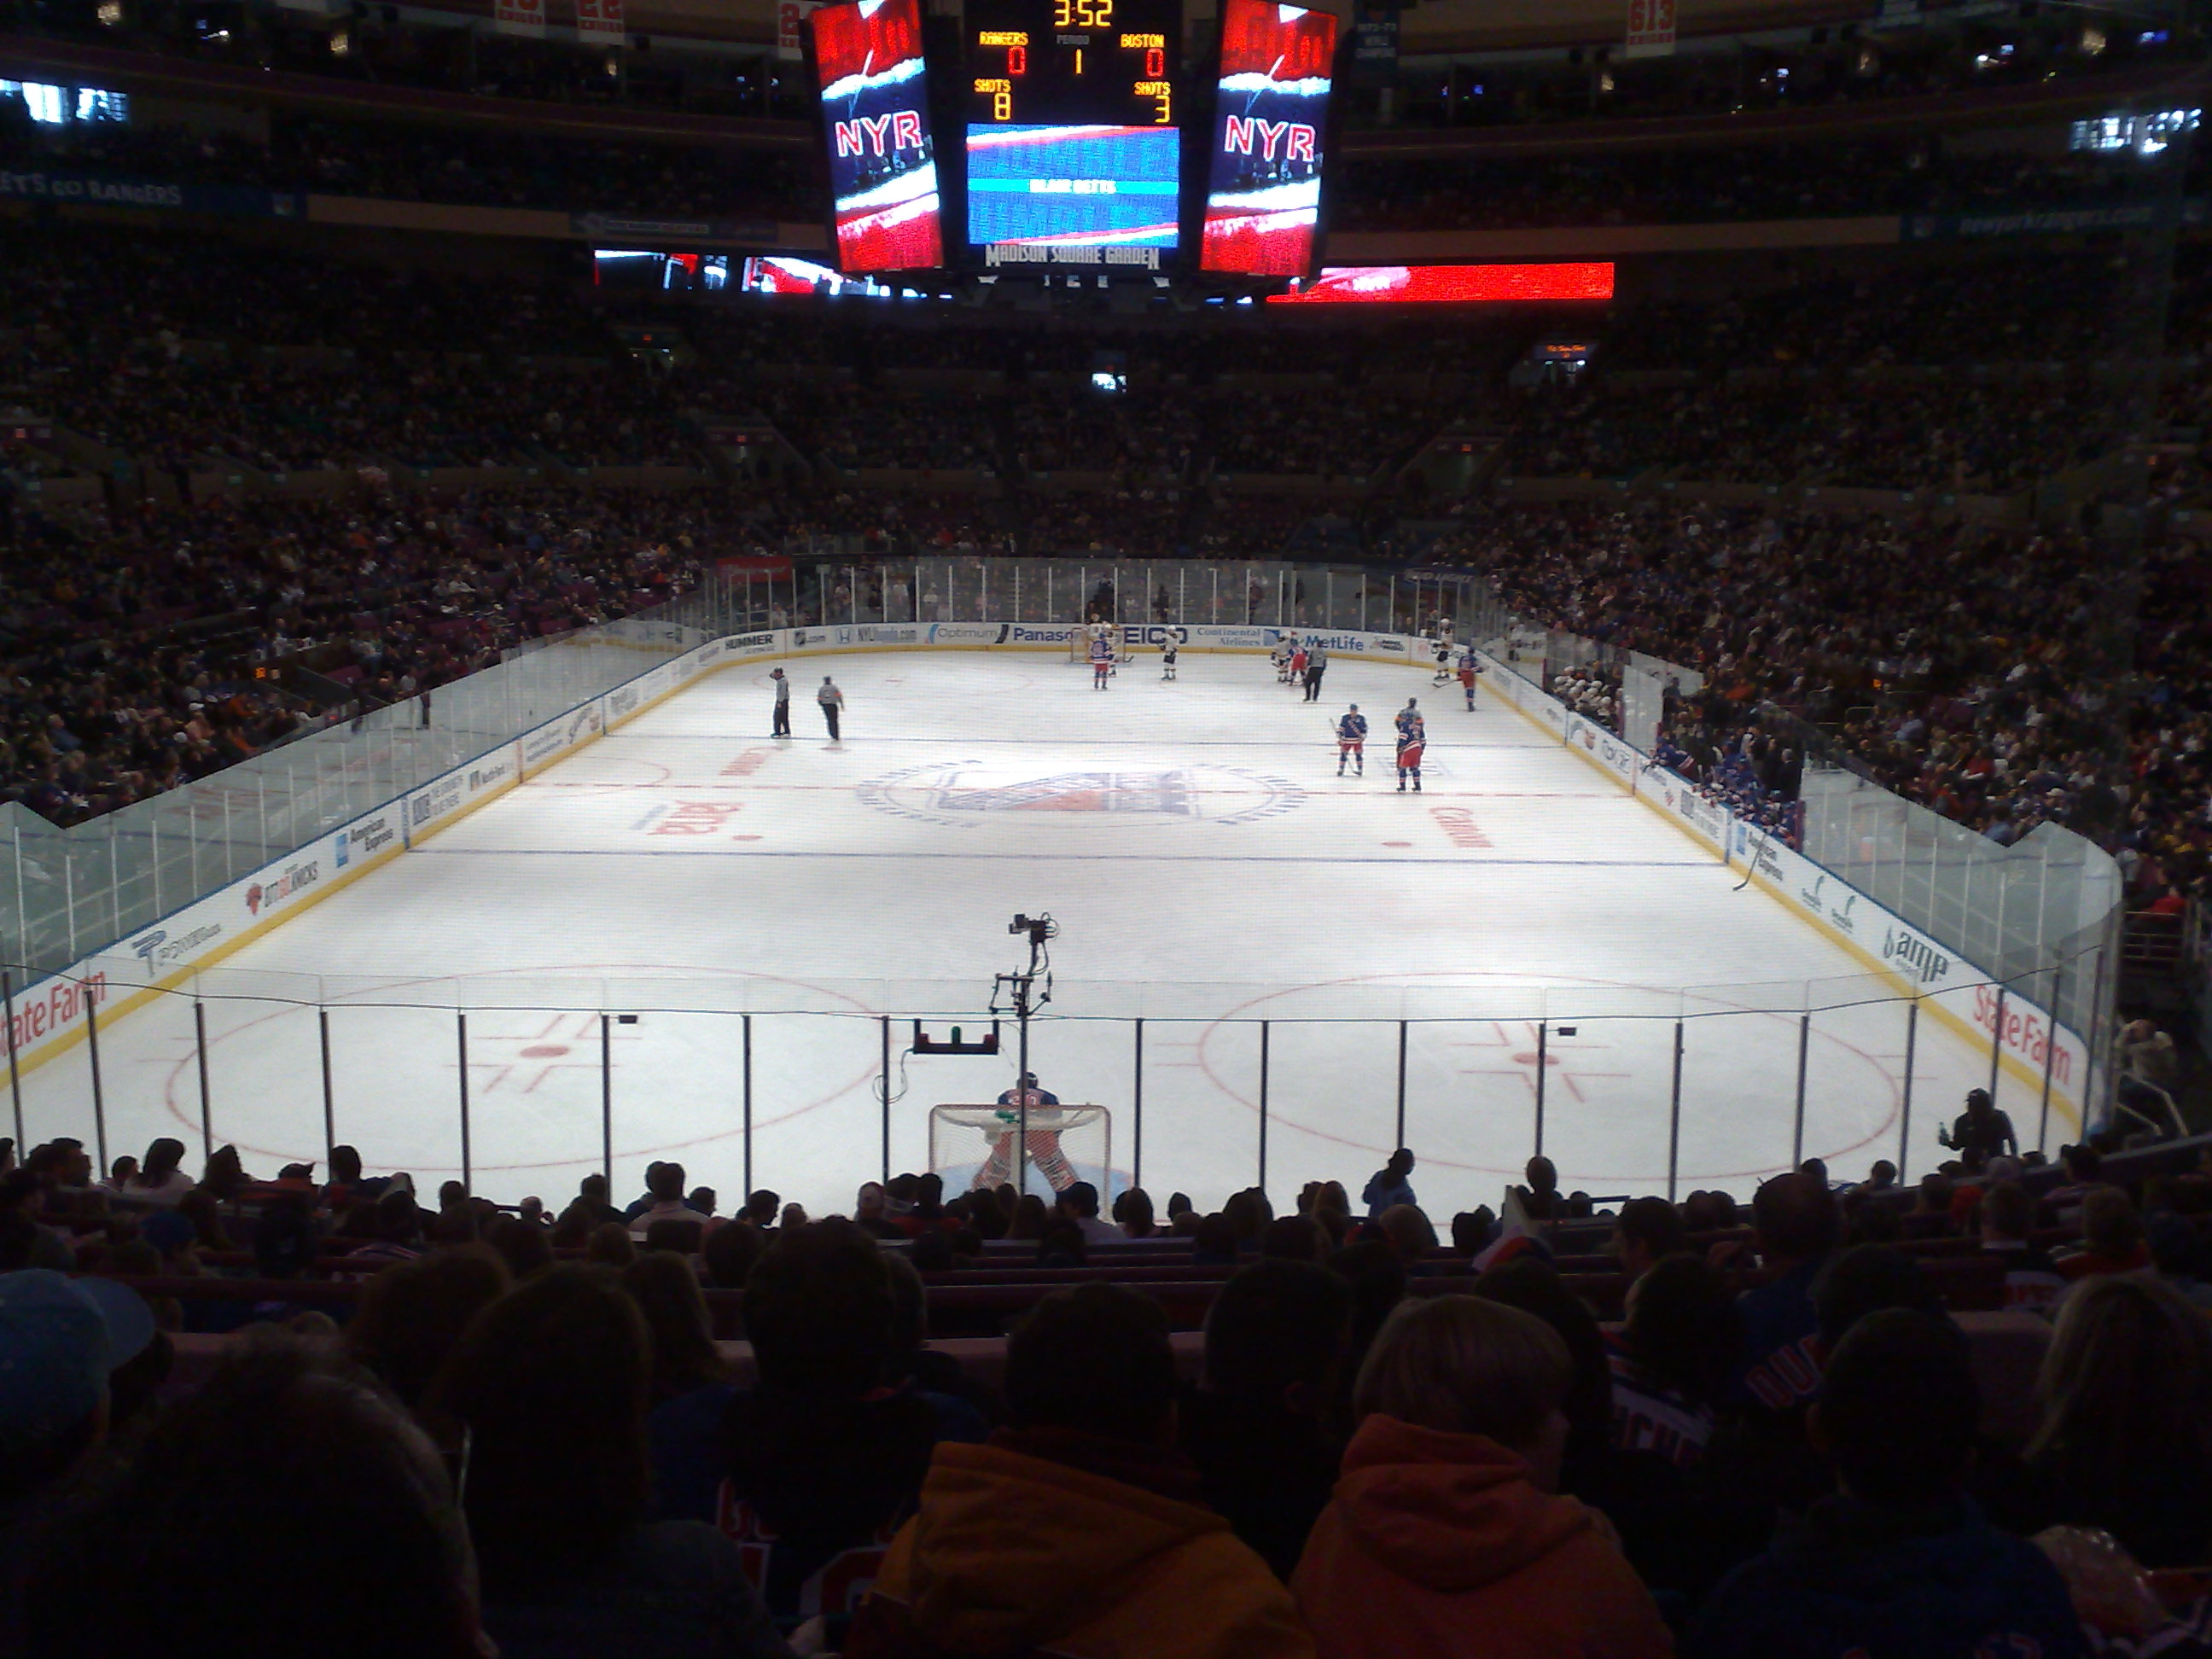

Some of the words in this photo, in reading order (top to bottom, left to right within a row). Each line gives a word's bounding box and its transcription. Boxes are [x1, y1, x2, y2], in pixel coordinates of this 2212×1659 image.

[1054, 0, 1112, 26] 3:52
[979, 32, 1029, 46] RANGERS
[1120, 33, 1165, 48] BOSTON
[1008, 45, 1026, 74] 0
[1147, 48, 1164, 78] 0
[974, 78, 1011, 93] SHOTS
[1133, 81, 1171, 96] SHOTS
[993, 92, 1011, 120] 8
[1155, 95, 1171, 124] 3
[835, 109, 924, 157] NYR
[1224, 114, 1316, 163] NYR
[985, 244, 1048, 268] MADISON
[1051, 246, 1103, 265] SQUARE
[1105, 248, 1161, 271] GARDEN
[938, 627, 998, 638] Optimum
[1013, 626, 1074, 642] Panaso
[1124, 626, 1188, 644] EICO
[1196, 627, 1260, 637] Continental
[725, 634, 774, 650] HUMMER
[1304, 635, 1364, 651] MetLife
[1896, 932, 1948, 982] amp
